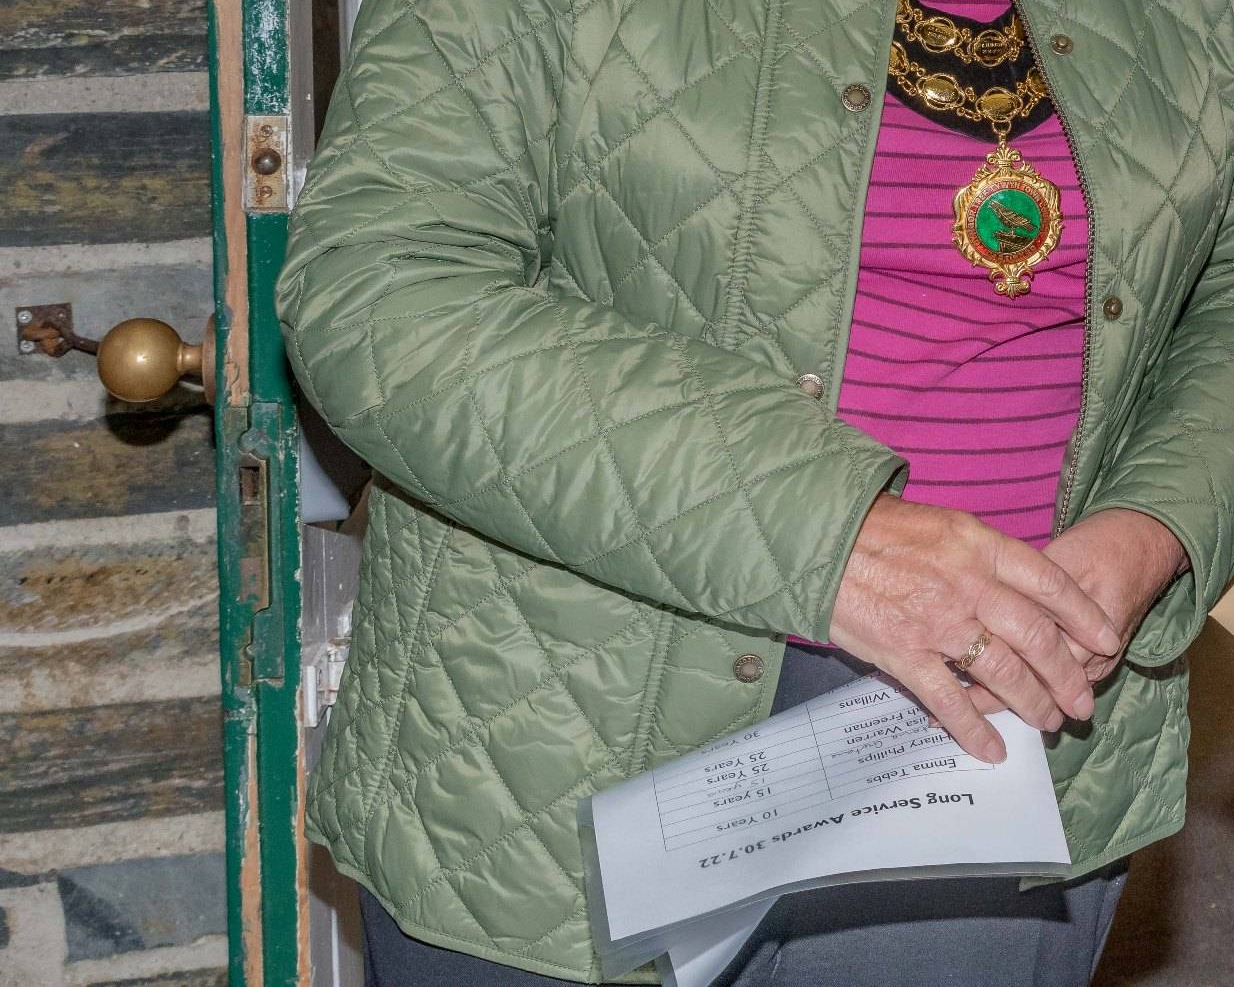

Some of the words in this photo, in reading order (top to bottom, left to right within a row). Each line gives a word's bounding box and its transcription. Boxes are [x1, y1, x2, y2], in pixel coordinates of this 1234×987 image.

[839, 691, 891, 709] Willans
[843, 712, 904, 734] Freeman
[906, 716, 929, 728] uisa
[743, 730, 761, 741] 30
[846, 725, 903, 745] Warren
[910, 734, 951, 749] Hilary
[749, 751, 767, 763] 25
[857, 745, 906, 764] Phillips
[703, 757, 745, 773] Years
[751, 763, 771, 775] 25
[913, 758, 957, 771] Emma
[706, 770, 748, 785] Years
[866, 768, 910, 784] Tebbs
[712, 791, 752, 808] years
[756, 786, 772, 799] 15
[926, 792, 975, 806] Long
[762, 808, 778, 821] 10
[850, 796, 923, 817] Service
[715, 815, 759, 833] Years
[771, 813, 845, 844] Awards
[698, 839, 767, 869] 30.7.22
